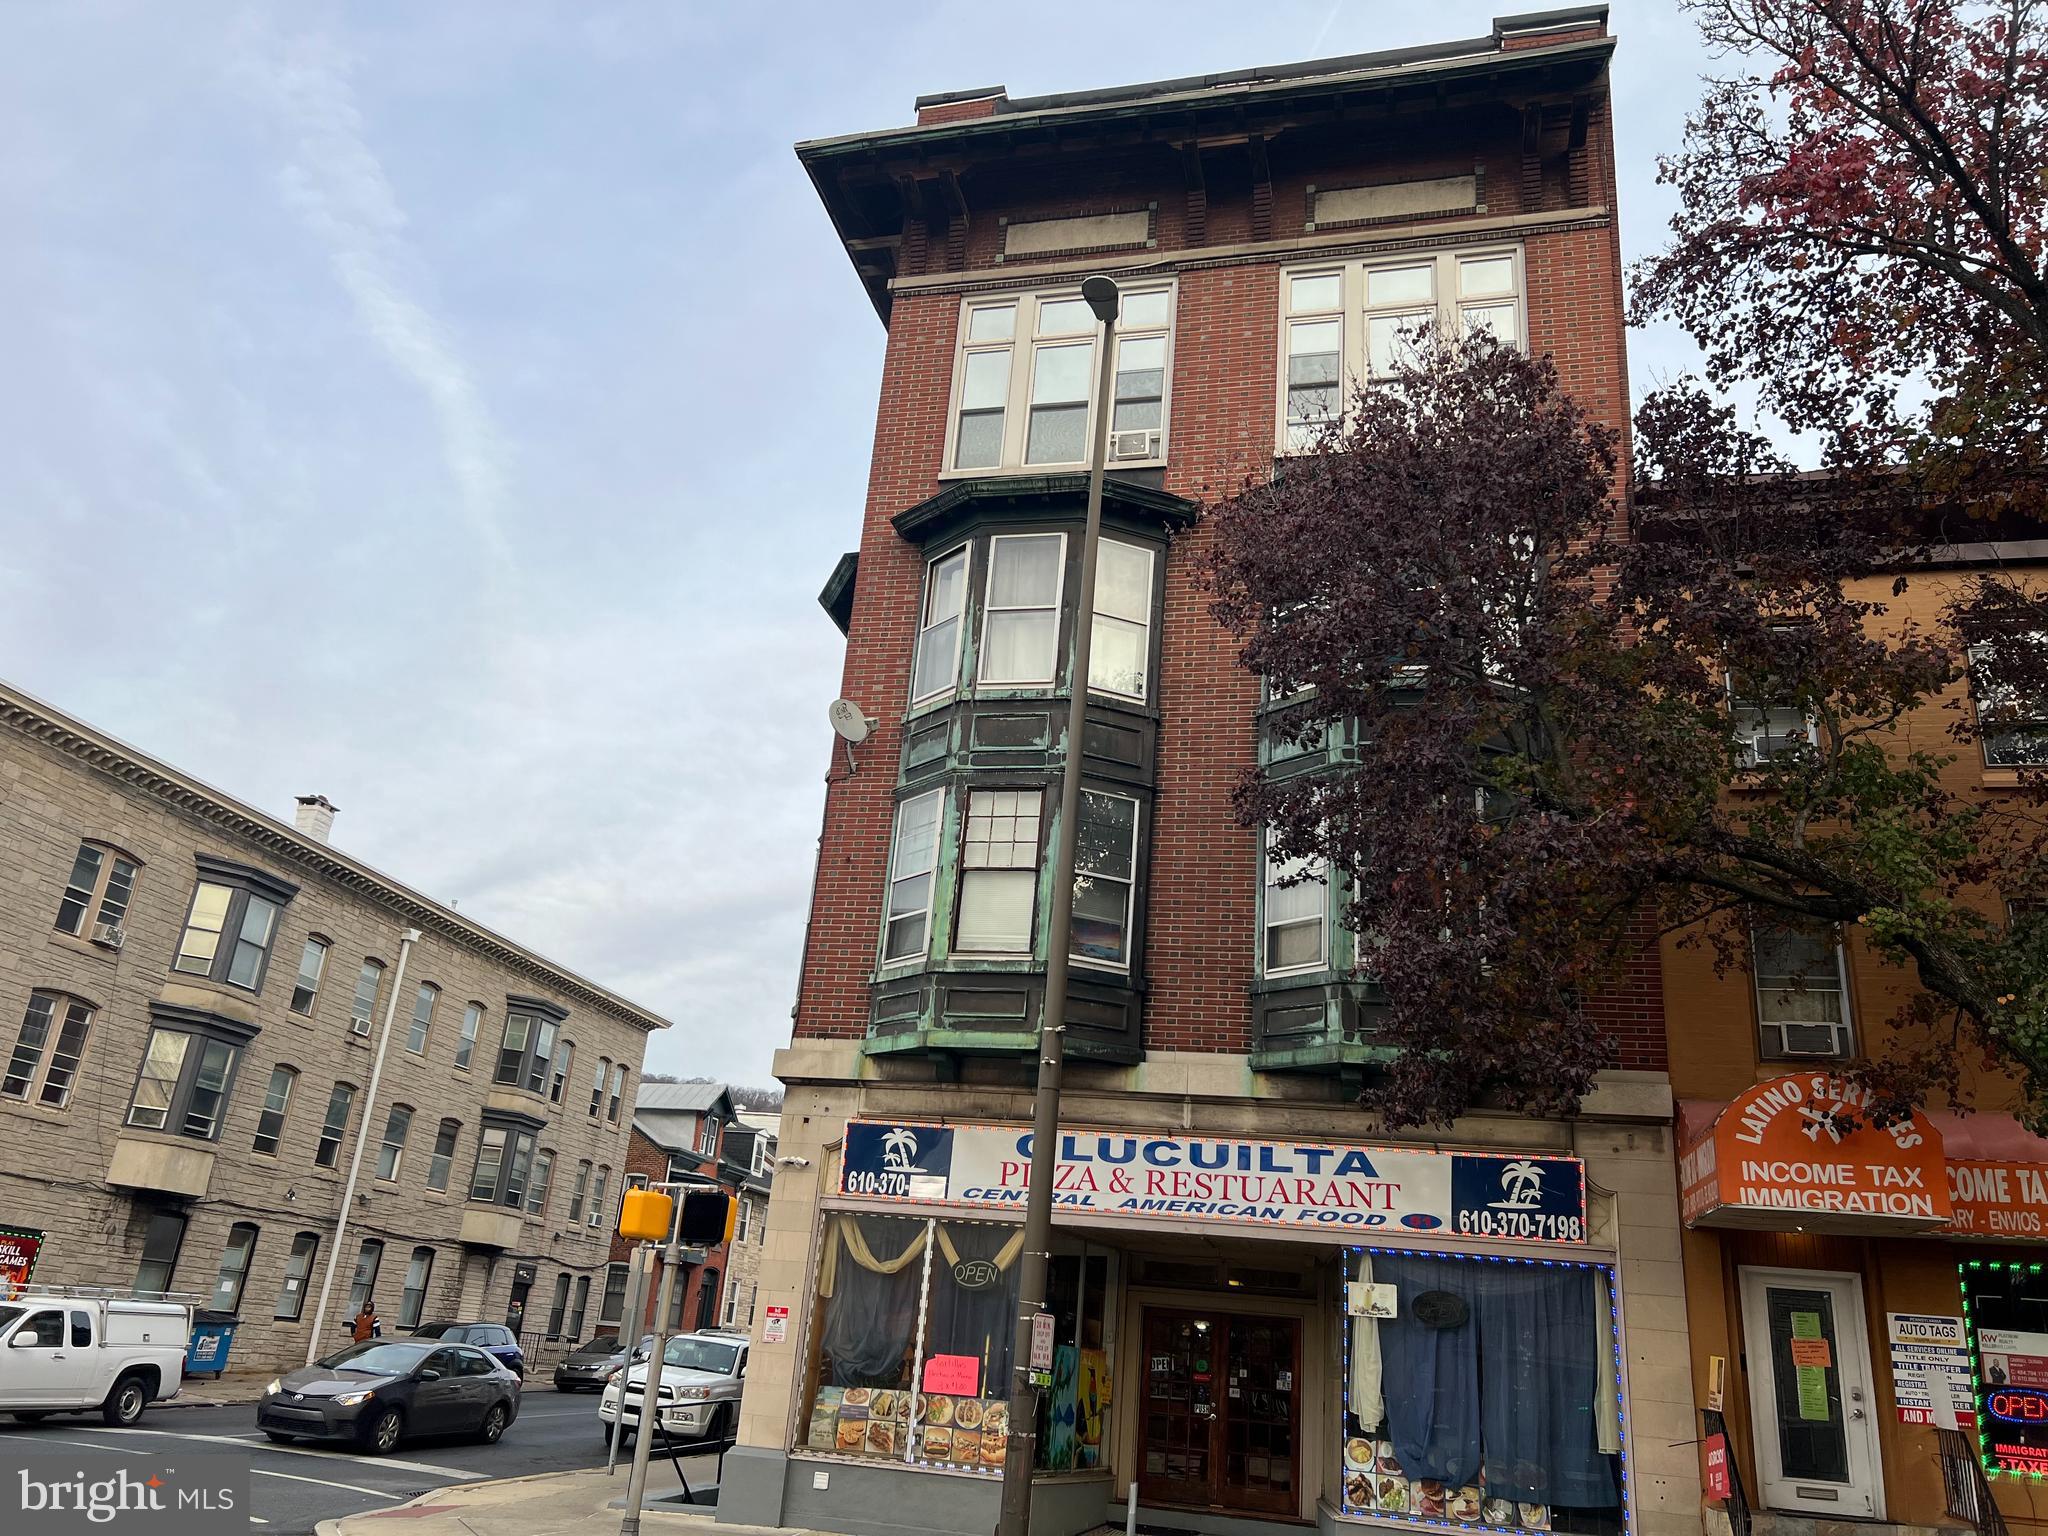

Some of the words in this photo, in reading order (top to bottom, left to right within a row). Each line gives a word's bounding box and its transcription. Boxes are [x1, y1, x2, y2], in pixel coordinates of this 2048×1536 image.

[1735, 1080, 1803, 1145] LATINO
[1000, 1161, 1099, 1192] PIZA
[1108, 1167, 1134, 1194] &
[1144, 1169, 1401, 1210] RESTUARANT
[1741, 1160, 1856, 1185] INCOME
[1865, 1165, 1924, 1188] TAX
[2015, 1169, 2048, 1205] TA
[962, 1187, 1096, 1206] CENRAL
[1118, 1198, 1284, 1219] AMERICAN
[1297, 1209, 1387, 1226] FOOD
[1739, 1186, 1934, 1216] IMMIGRATION
[1458, 1209, 1580, 1240] 610-370-7198
[1988, 1209, 2041, 1232] ENVIOS
[954, 1264, 998, 1283] OPEN
[1899, 1323, 1927, 1337] AUTO
[1929, 1326, 1956, 1338] TAGS
[1907, 1346, 1936, 1354] SERVICES
[1936, 1347, 1958, 1355] ONLINE
[1897, 1362, 1919, 1370] TITLE
[1920, 1364, 1961, 1374] TRANSFER
[1903, 1409, 1924, 1423] AND
